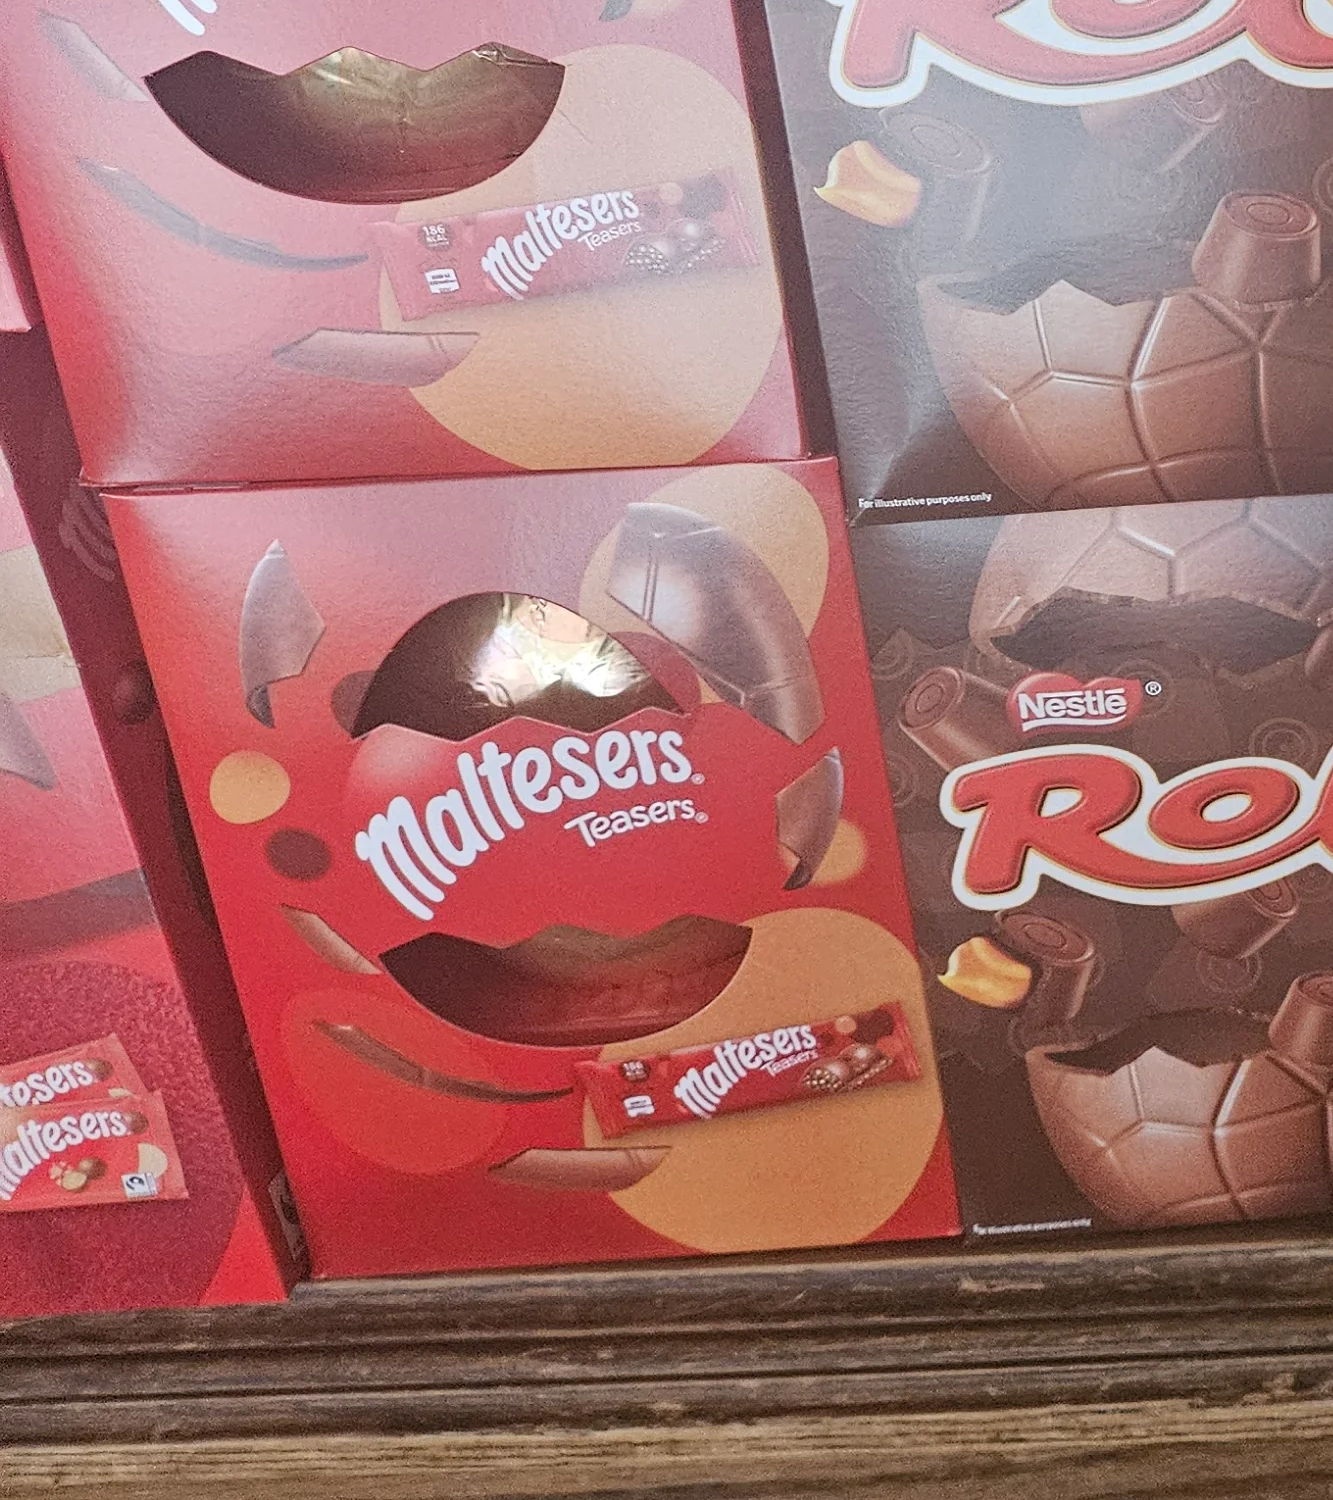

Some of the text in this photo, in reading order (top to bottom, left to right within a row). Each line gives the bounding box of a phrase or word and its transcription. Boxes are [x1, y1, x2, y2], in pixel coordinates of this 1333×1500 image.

[423, 223, 446, 236] 186
[482, 188, 641, 300] Maltesers
[578, 219, 642, 252] Teasers
[858, 491, 991, 508] For illustrative purposes only
[355, 729, 692, 921] Maltesers
[565, 797, 696, 847] Teasers
[675, 1025, 818, 1119] Maltesers
[760, 1049, 820, 1077] Teasers
